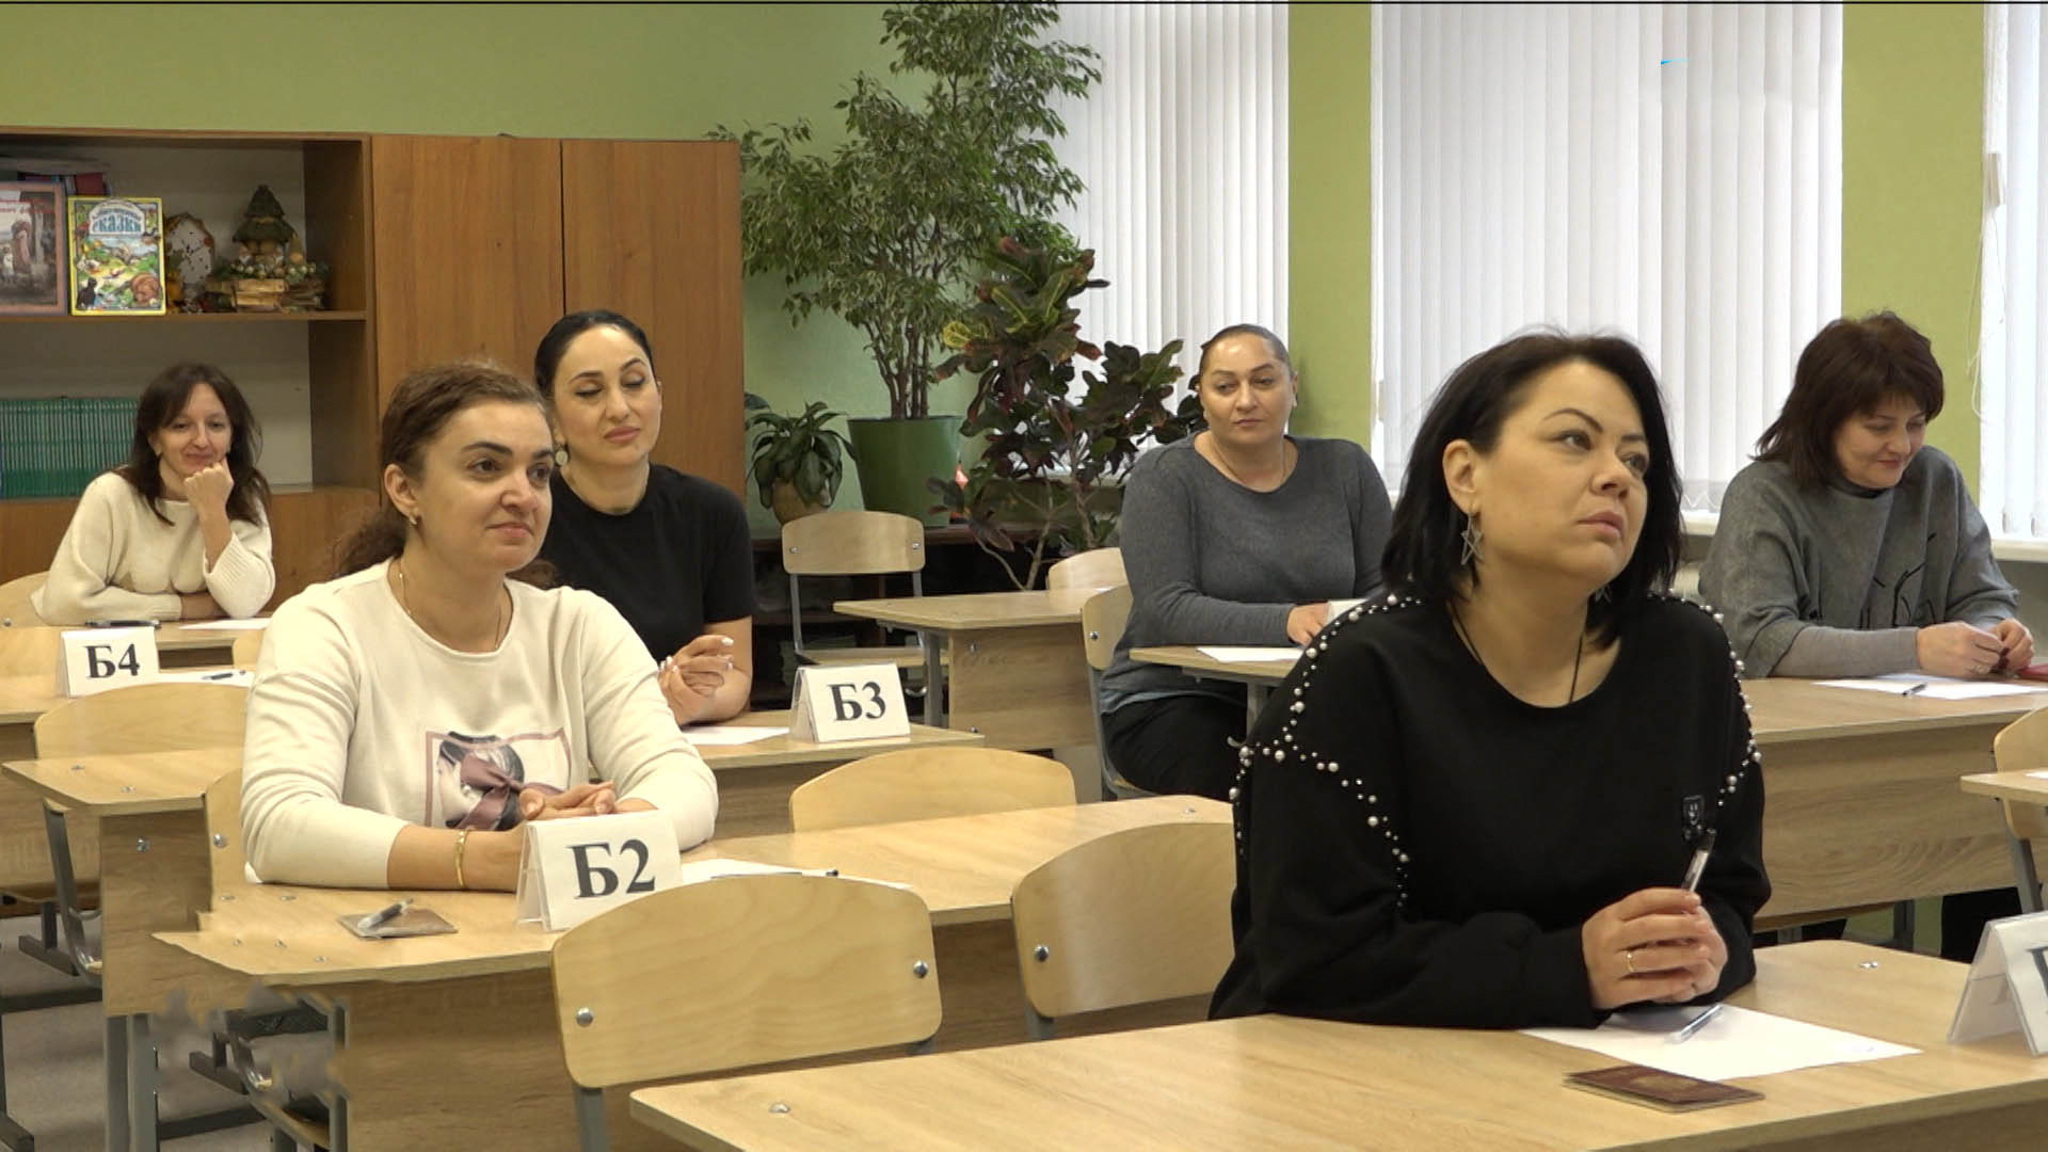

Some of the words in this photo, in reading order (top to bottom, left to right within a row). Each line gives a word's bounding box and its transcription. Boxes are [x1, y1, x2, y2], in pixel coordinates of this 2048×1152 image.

[84, 643, 140, 680] Б4
[828, 681, 886, 721] Б3
[566, 839, 656, 899] Б2
